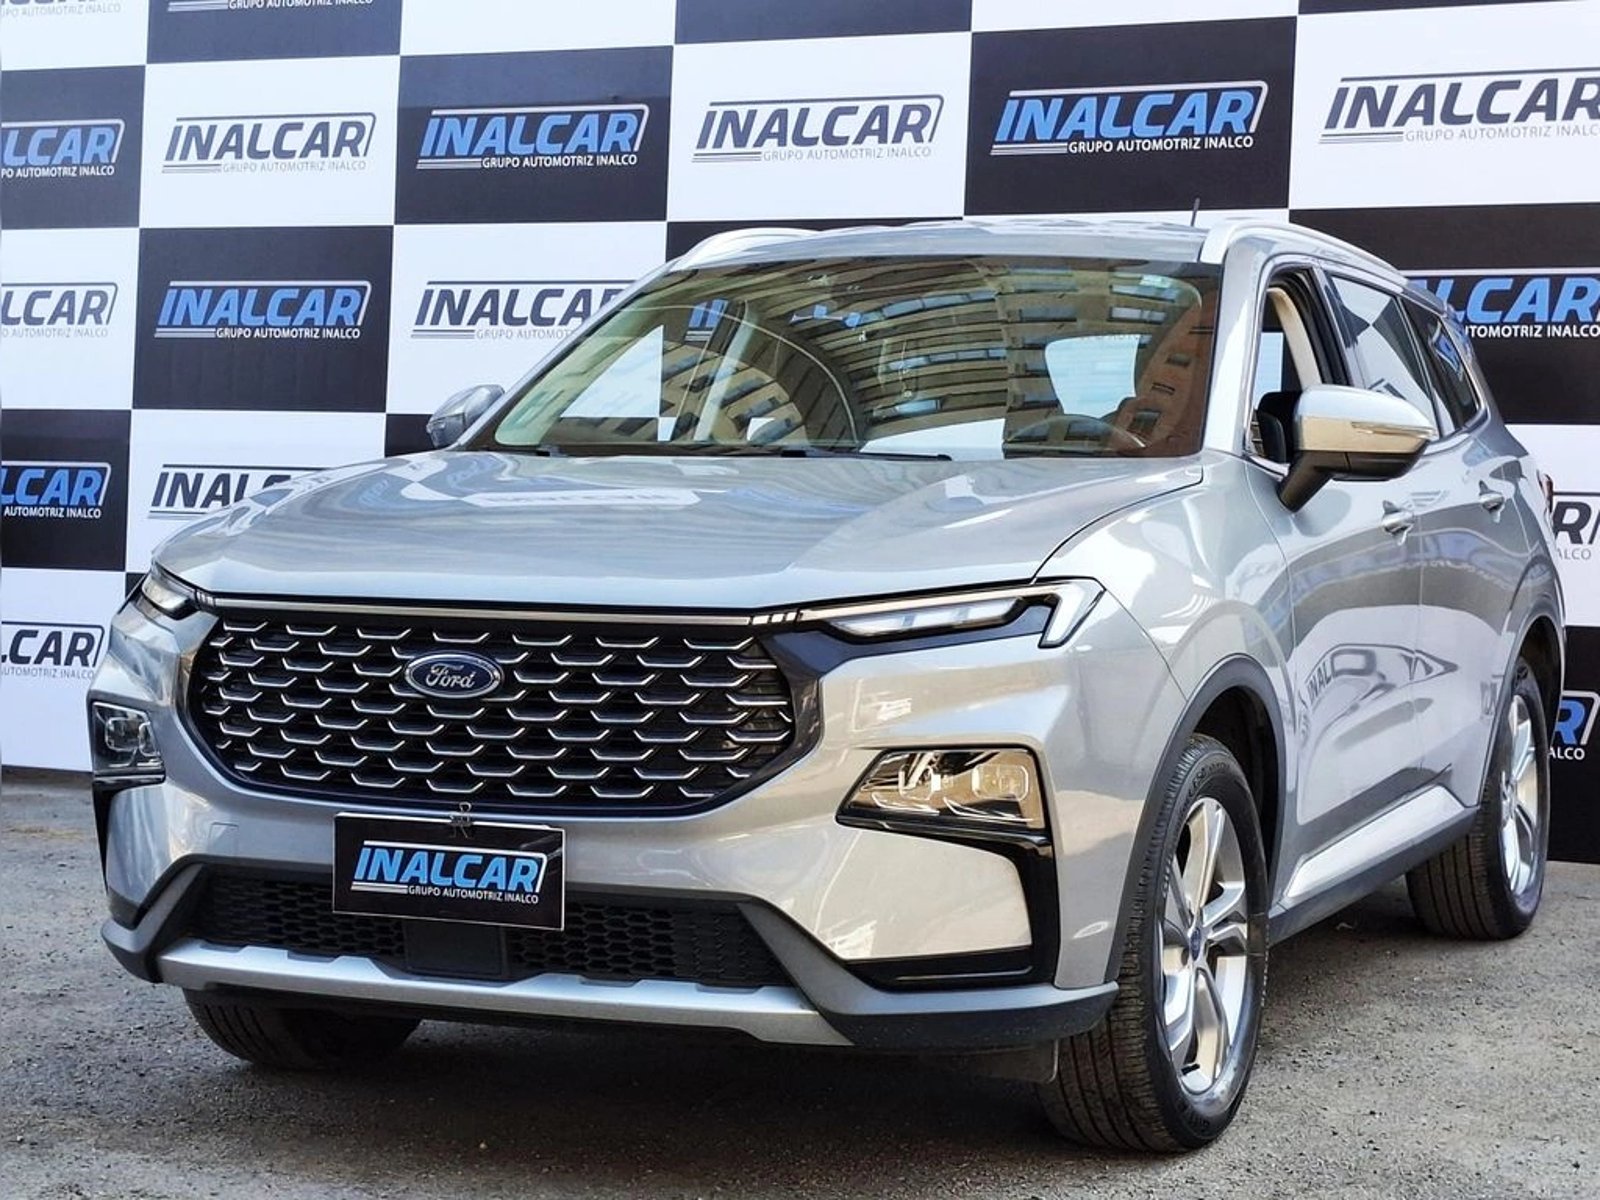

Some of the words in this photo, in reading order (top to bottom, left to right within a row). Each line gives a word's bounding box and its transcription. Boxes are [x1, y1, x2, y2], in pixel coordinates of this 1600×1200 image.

[995, 91, 1254, 141] INALCAR
[1324, 77, 1600, 129] INALCAR
[420, 113, 639, 157] INALCAR
[696, 104, 931, 149] INALCAR
[1405, 130, 1454, 142] GRUPO
[1459, 126, 1551, 140] AUTOMOTRIZ
[3, 128, 115, 167] LCAR
[165, 121, 366, 161] INALCAR
[764, 151, 803, 162] GRUPO
[807, 148, 884, 160] AUTOMOTRIZ
[887, 146, 931, 158] INALCO
[1069, 140, 1113, 154] GRUPO
[1116, 138, 1200, 152] AUTOMOTRIZ
[1204, 136, 1254, 148] INALCO
[16, 167, 77, 178] AUTOMOTRIZ
[79, 165, 115, 176] INALCO
[223, 163, 258, 173] GRUPO
[260, 162, 323, 173] AUTOMOTRIZ
[328, 161, 366, 171] INALCO
[482, 157, 520, 169] GRUPO
[523, 155, 594, 168] AUTOMOTRIZ
[597, 154, 637, 166] INALCO
[1, 290, 109, 326] LCAR
[157, 288, 361, 326] INALCAR
[1410, 277, 1600, 324] CAR
[216, 328, 251, 338] GRUPO
[253, 328, 319, 338] AUTOMOTRIZ
[322, 328, 361, 339] INALCO
[476, 329, 513, 339] GRUPO
[1547, 324, 1600, 338] INALCO
[4, 506, 64, 517] AUTOMOTRIZ
[66, 508, 102, 519] INALCO
[1, 629, 95, 667] CAR
[425, 663, 476, 689] Ford
[354, 847, 539, 893] INALCAR
[408, 885, 441, 896] GRUPO
[443, 888, 503, 901] AUTOMOTRIZ
[504, 894, 540, 904] INALCO
